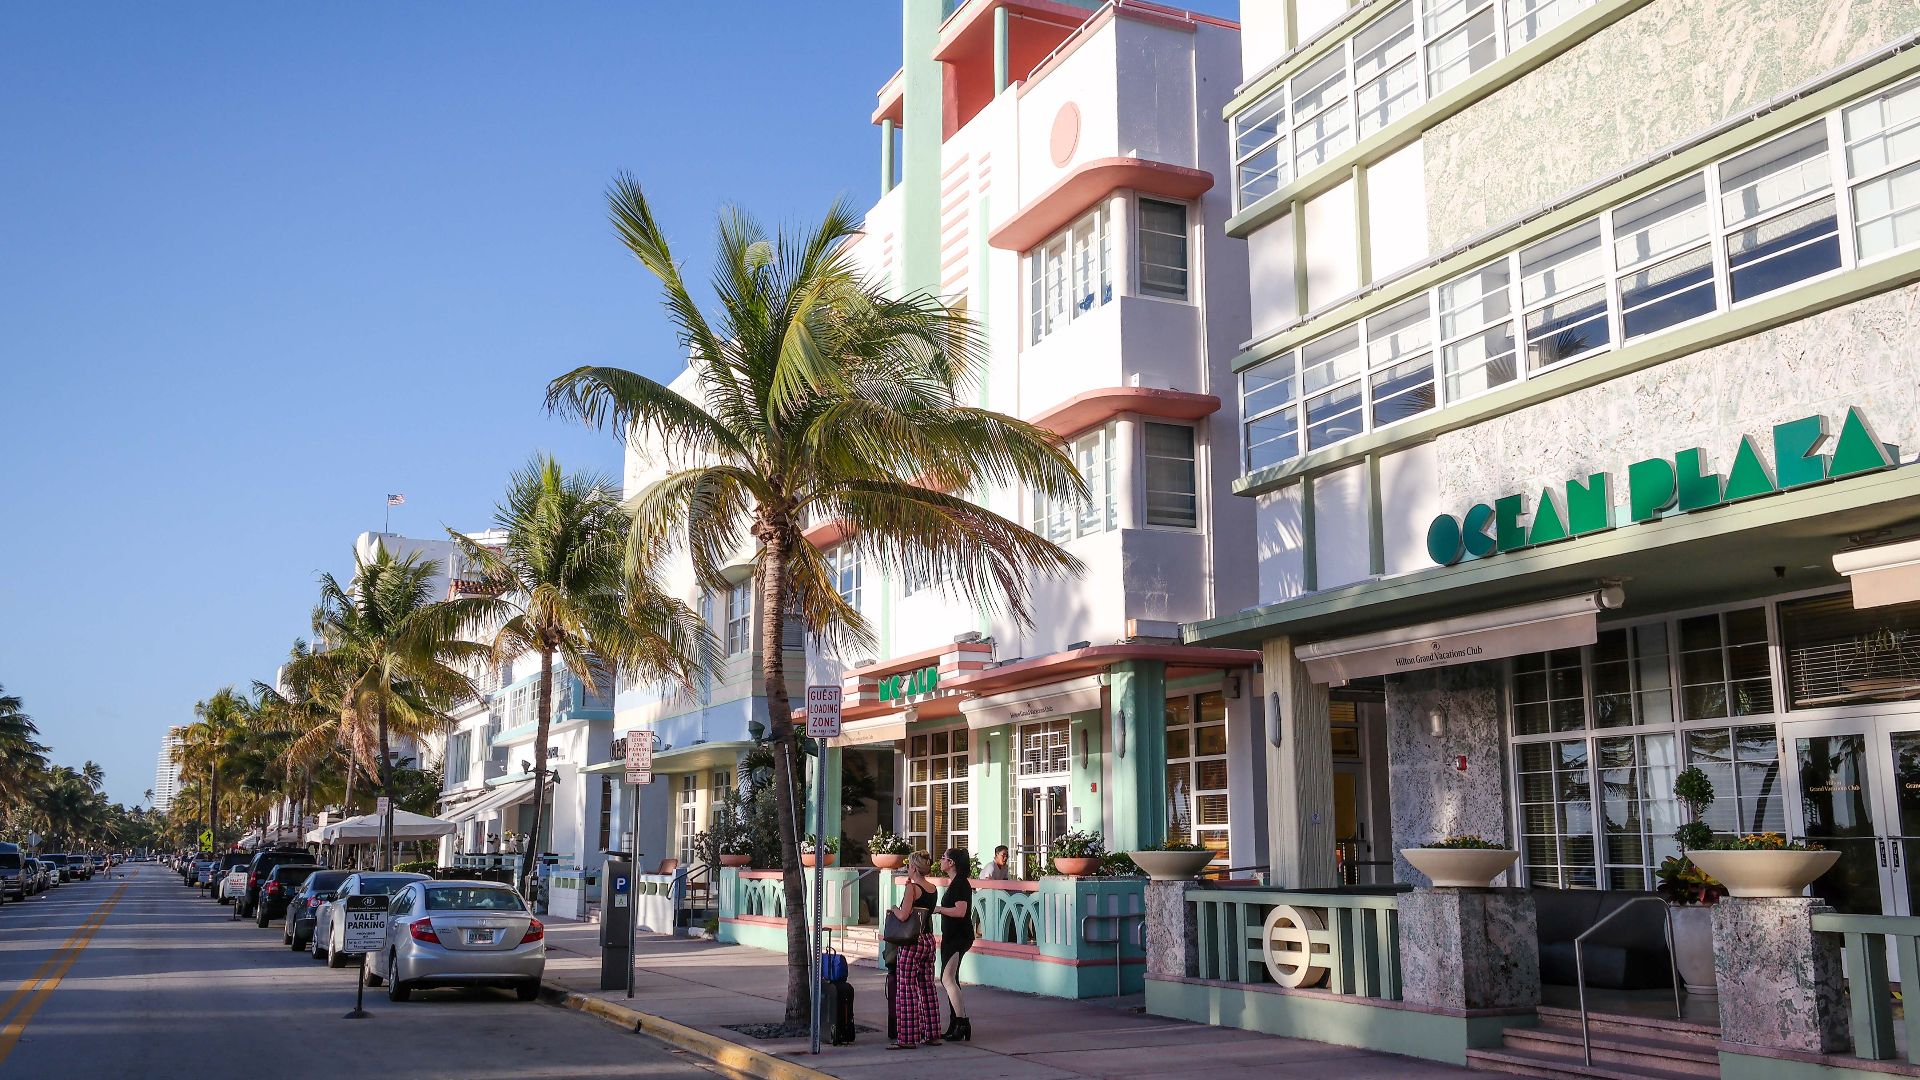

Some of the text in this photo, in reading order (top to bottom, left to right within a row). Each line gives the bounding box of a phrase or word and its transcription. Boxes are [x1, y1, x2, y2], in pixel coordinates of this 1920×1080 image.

[1427, 405, 1895, 566] OCEAN PLAZA
[1395, 657, 1415, 666] Hilton
[1415, 653, 1434, 663] Grand
[1434, 649, 1466, 661] Vacations
[1466, 645, 1483, 656] Club
[810, 690, 838, 701] GUEST
[810, 704, 838, 714] LOADING
[812, 717, 835, 727] ZONE
[616, 877, 626, 890] P
[347, 921, 385, 929] PARKING
